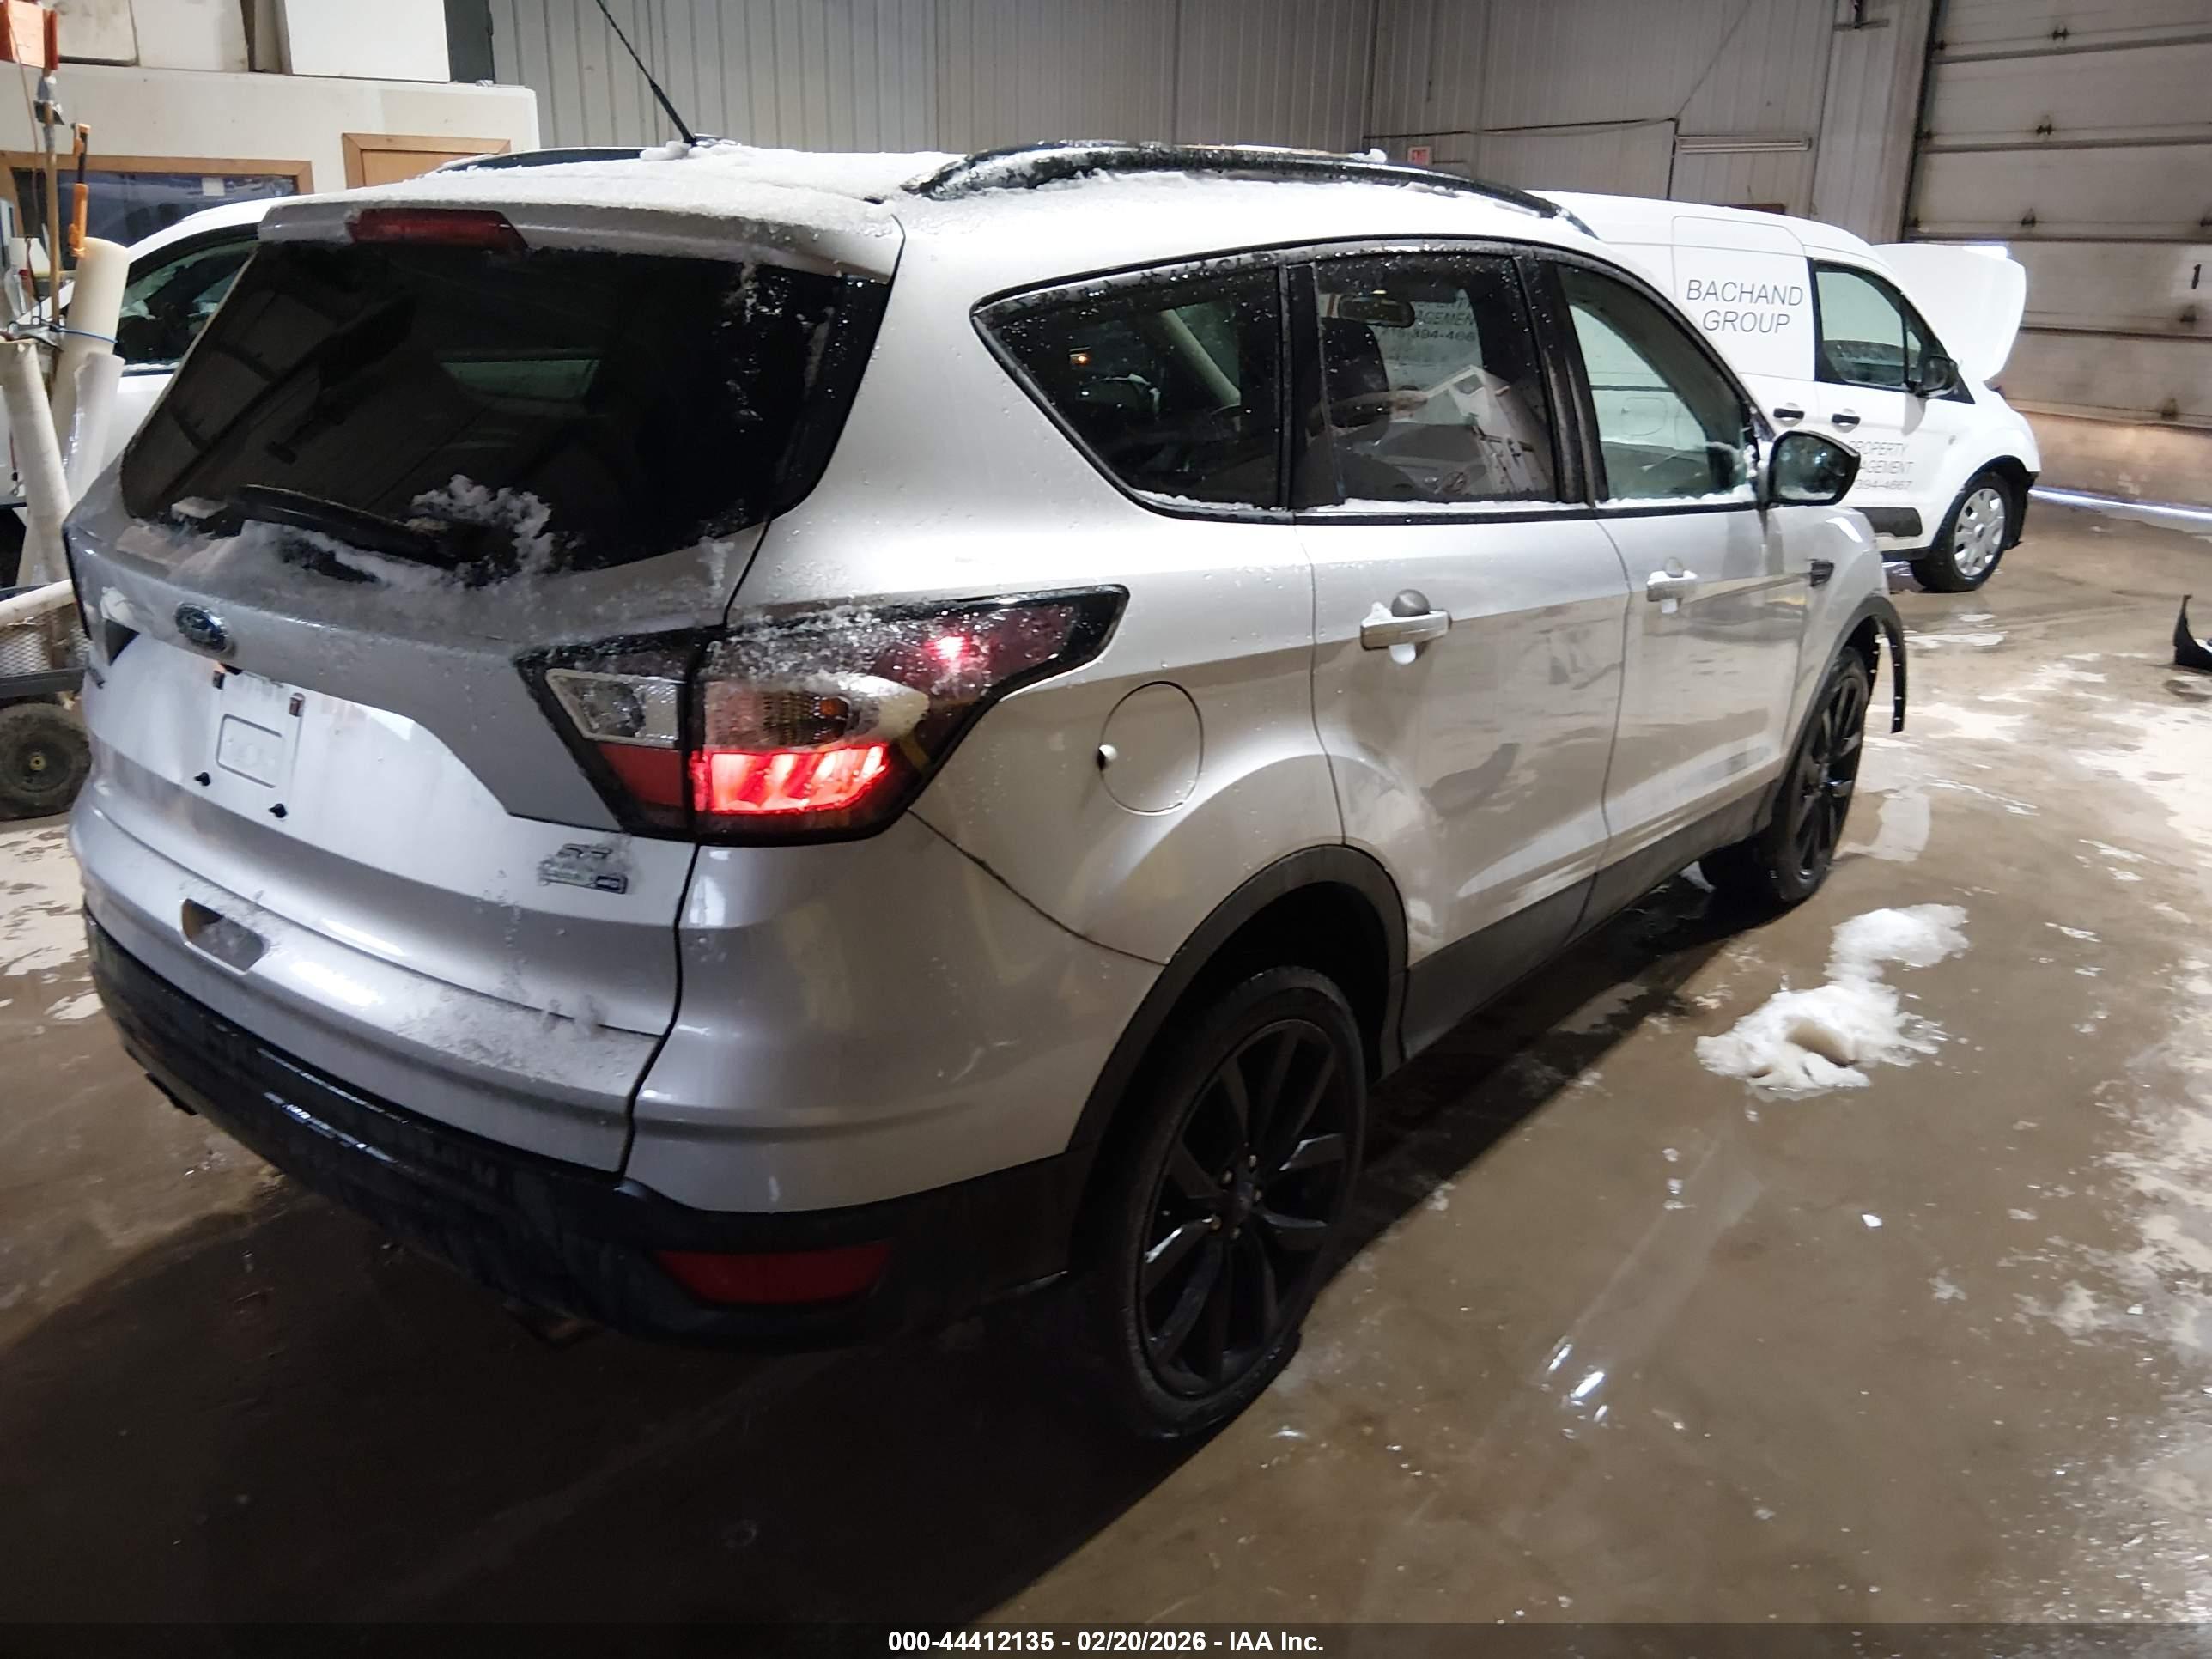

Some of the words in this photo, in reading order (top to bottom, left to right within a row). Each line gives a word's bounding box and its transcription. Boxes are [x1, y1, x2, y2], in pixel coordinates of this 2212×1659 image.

[2191, 264, 2202, 289] 1
[1686, 279, 1803, 306] BACHAND
[1703, 309, 1791, 333] GROUP
